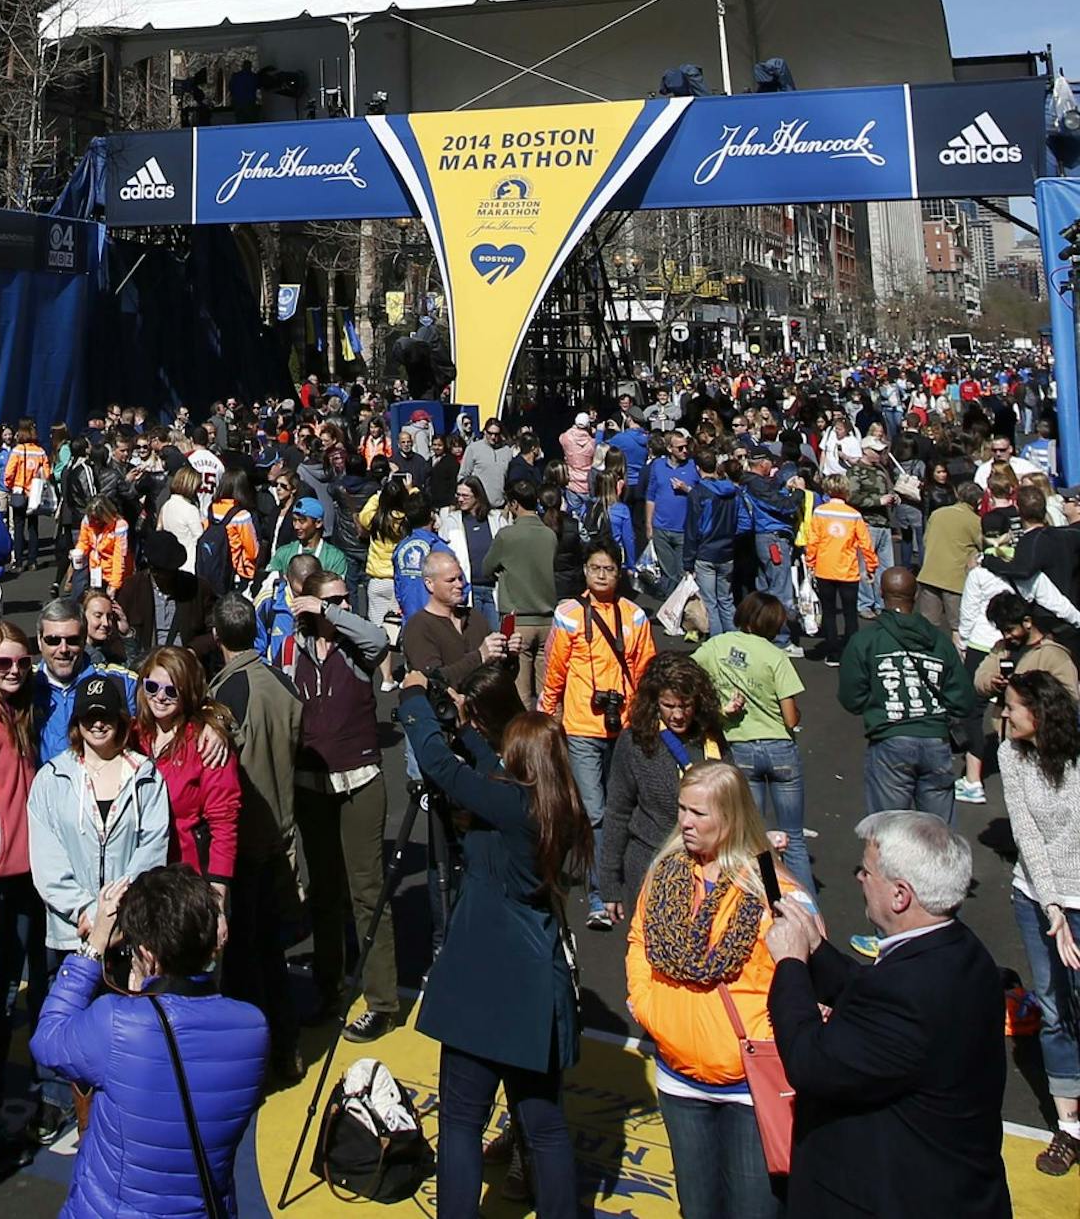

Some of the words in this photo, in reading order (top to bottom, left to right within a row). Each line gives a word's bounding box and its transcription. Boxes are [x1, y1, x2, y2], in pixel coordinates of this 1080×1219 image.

[442, 134, 491, 151] 2014
[501, 128, 595, 149] BOSTON
[439, 149, 594, 171] MARATHON
[693, 124, 768, 185] John
[938, 140, 1022, 165] adidas
[215, 150, 275, 204] John
[120, 183, 176, 201] adidas
[477, 208, 540, 216] MARATHON
[502, 200, 541, 208] BOSTON
[478, 255, 515, 263] BOSTON
